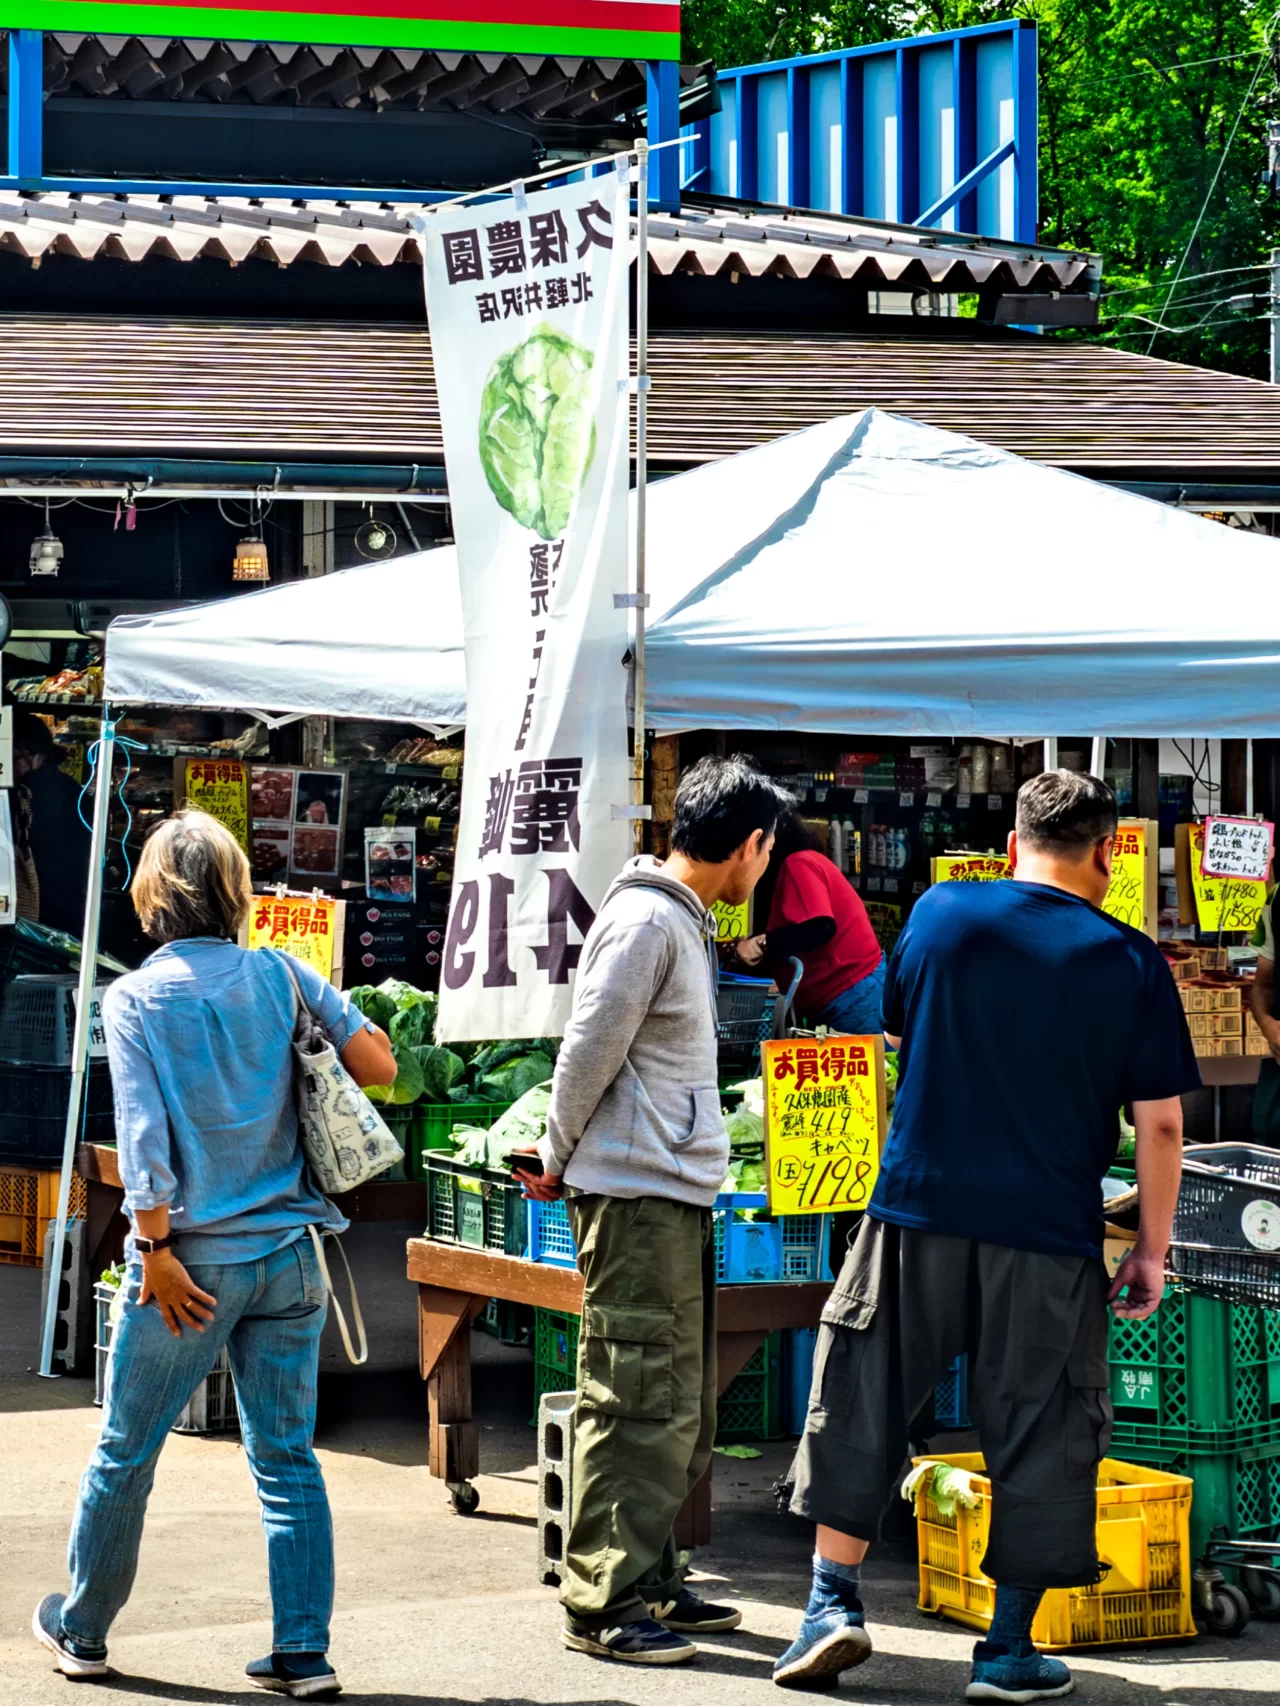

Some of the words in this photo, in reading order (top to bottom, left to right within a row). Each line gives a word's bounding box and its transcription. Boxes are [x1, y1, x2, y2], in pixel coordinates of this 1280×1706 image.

[191, 763, 243, 786] お買得品
[255, 904, 329, 941] お買得品
[773, 1045, 869, 1091] お買得品
[810, 1107, 852, 1132] 419
[809, 1138, 870, 1157] キャベツ
[778, 1159, 799, 1180] 1玉
[797, 1156, 872, 1208] ¥198
